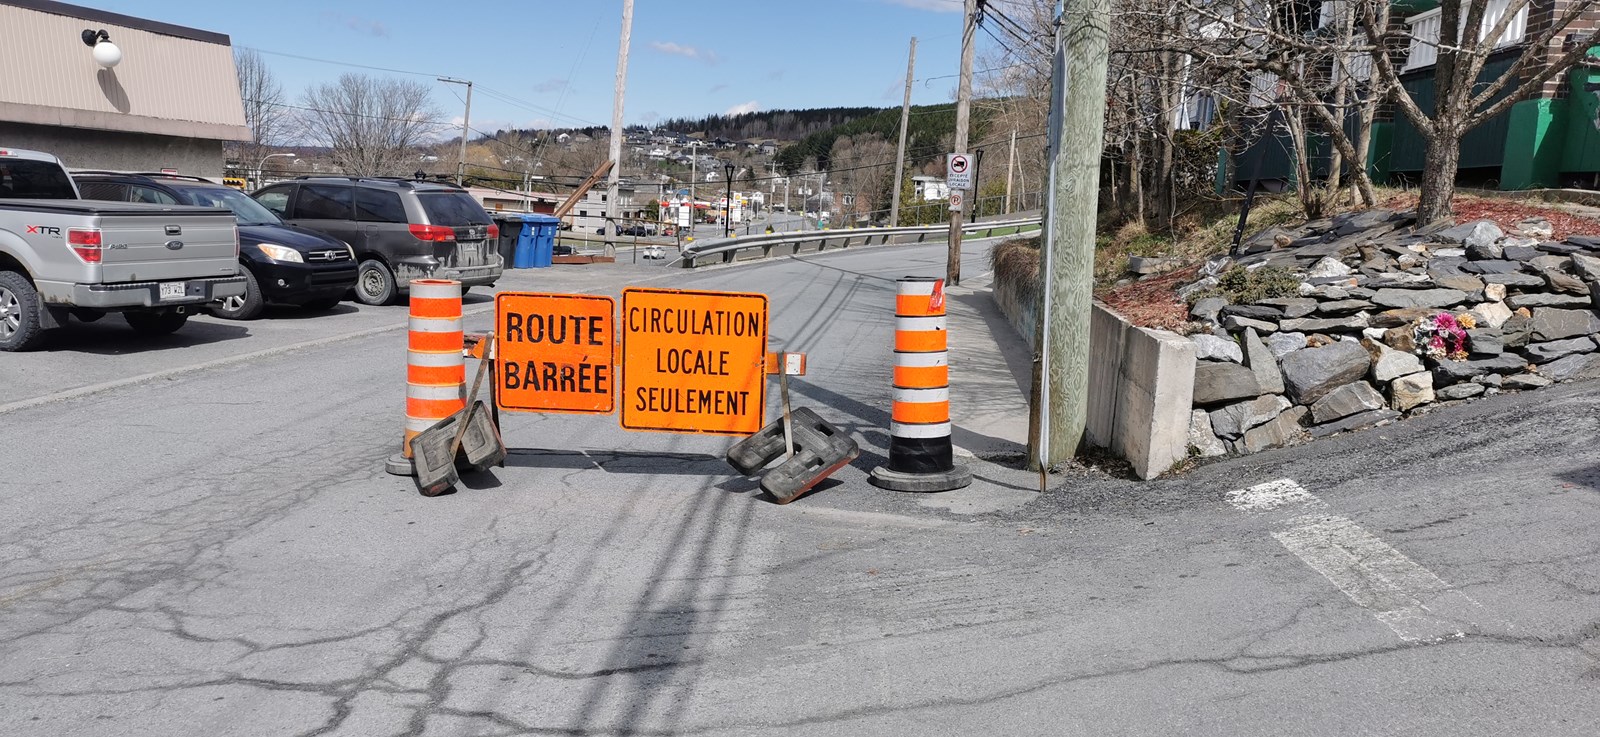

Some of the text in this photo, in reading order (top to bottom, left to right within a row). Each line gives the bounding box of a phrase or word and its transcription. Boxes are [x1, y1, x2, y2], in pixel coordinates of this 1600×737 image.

[27, 225, 61, 236] XTR
[506, 312, 603, 346] ROUTE
[629, 307, 760, 338] CIRCULATION
[505, 356, 608, 394] BARRÉE
[656, 348, 730, 376] LOCALE
[636, 387, 750, 416] SEULEMENT
